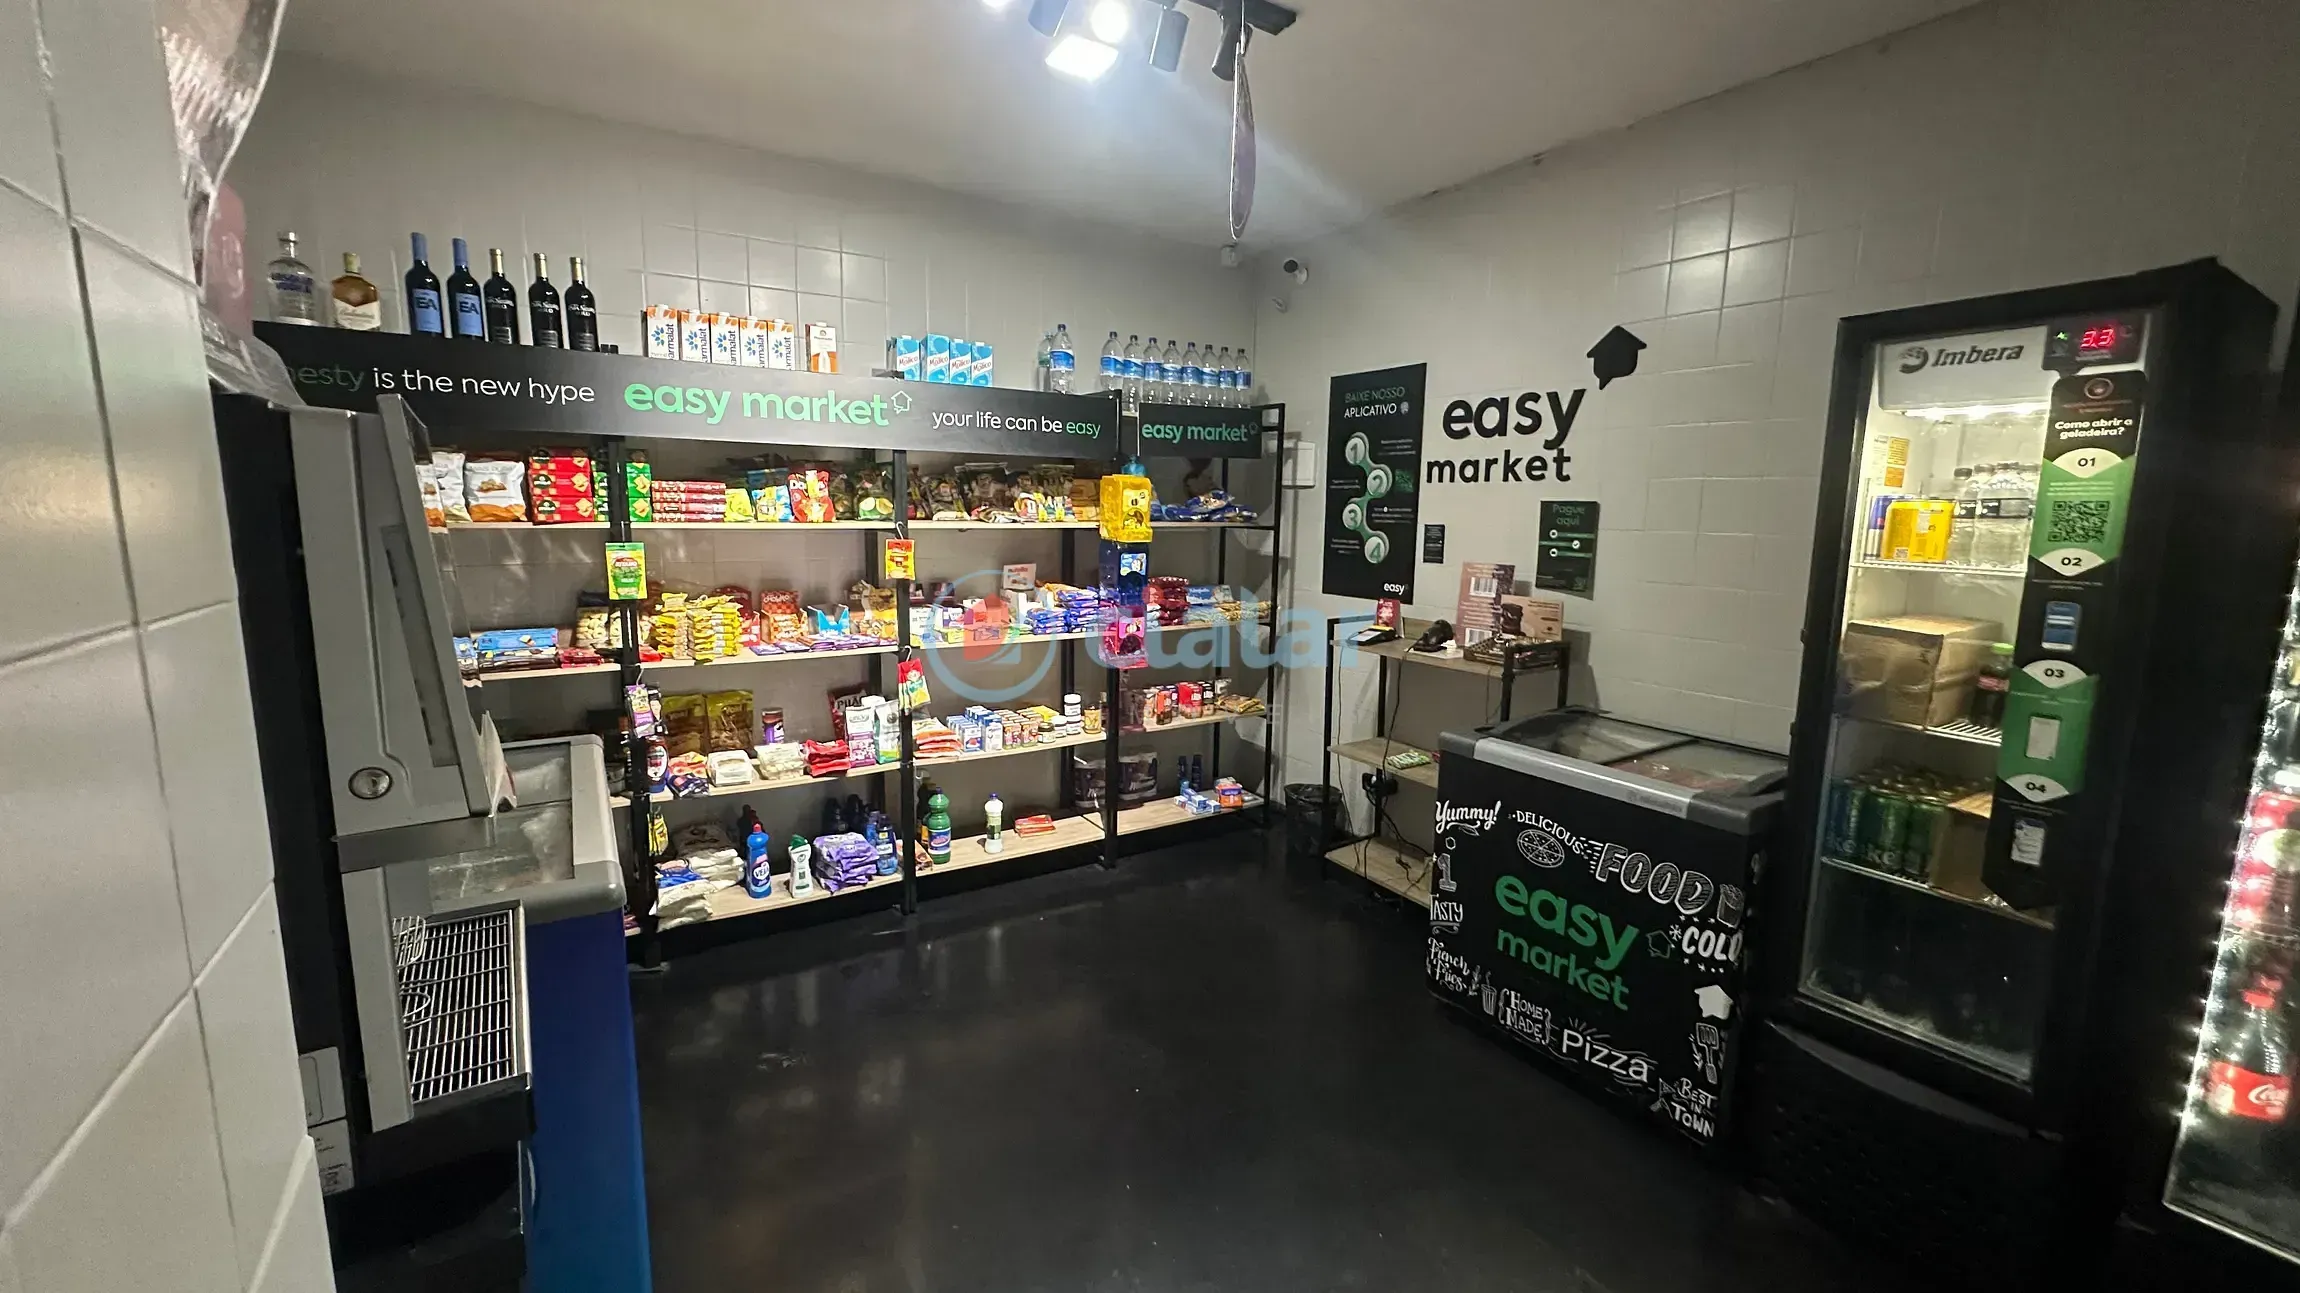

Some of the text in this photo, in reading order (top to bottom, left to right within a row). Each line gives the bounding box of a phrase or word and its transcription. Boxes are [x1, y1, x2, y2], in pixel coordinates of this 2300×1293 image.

[460, 302, 480, 315] EA
[1931, 344, 2024, 367] Imbera
[374, 367, 395, 389] is
[401, 369, 453, 393] the
[462, 376, 521, 397] new
[528, 377, 595, 405] hype
[1344, 386, 1406, 404] BAIXE NOSSO
[624, 382, 889, 427] easy market
[1344, 402, 1397, 418] APLICATIVO
[932, 411, 1101, 439] your life can be easy
[1141, 422, 1248, 443] easy market
[1442, 388, 1587, 450] easy
[2054, 417, 2133, 430] Como abrir a
[2059, 426, 2125, 440] geladeira?
[1426, 447, 1572, 484] market
[2077, 457, 2097, 467] 01
[1372, 474, 1384, 494] 2
[1348, 509, 1358, 527] 3
[1552, 503, 1585, 516] Pague
[1556, 515, 1580, 527] aqui
[1369, 541, 1381, 563] 4
[2060, 556, 2083, 568] 02
[1383, 581, 1405, 596] easy
[2043, 667, 2065, 679] 03
[2025, 781, 2047, 793] 04
[1435, 800, 1502, 834] Yummy!
[1516, 810, 1583, 855] DELICIOUS
[1595, 842, 1714, 915] FOOD
[1428, 893, 1463, 923] TASTY
[1495, 875, 1640, 971] easy
[1428, 937, 1470, 976] French
[1681, 925, 1744, 965] COLD
[1433, 958, 1464, 992] Fries
[1497, 929, 1630, 1011] market
[1510, 991, 1544, 1019] HOME
[1505, 1007, 1543, 1039] MADE
[1561, 1028, 1649, 1083] Pizza
[1671, 1101, 1716, 1137] TOWN
